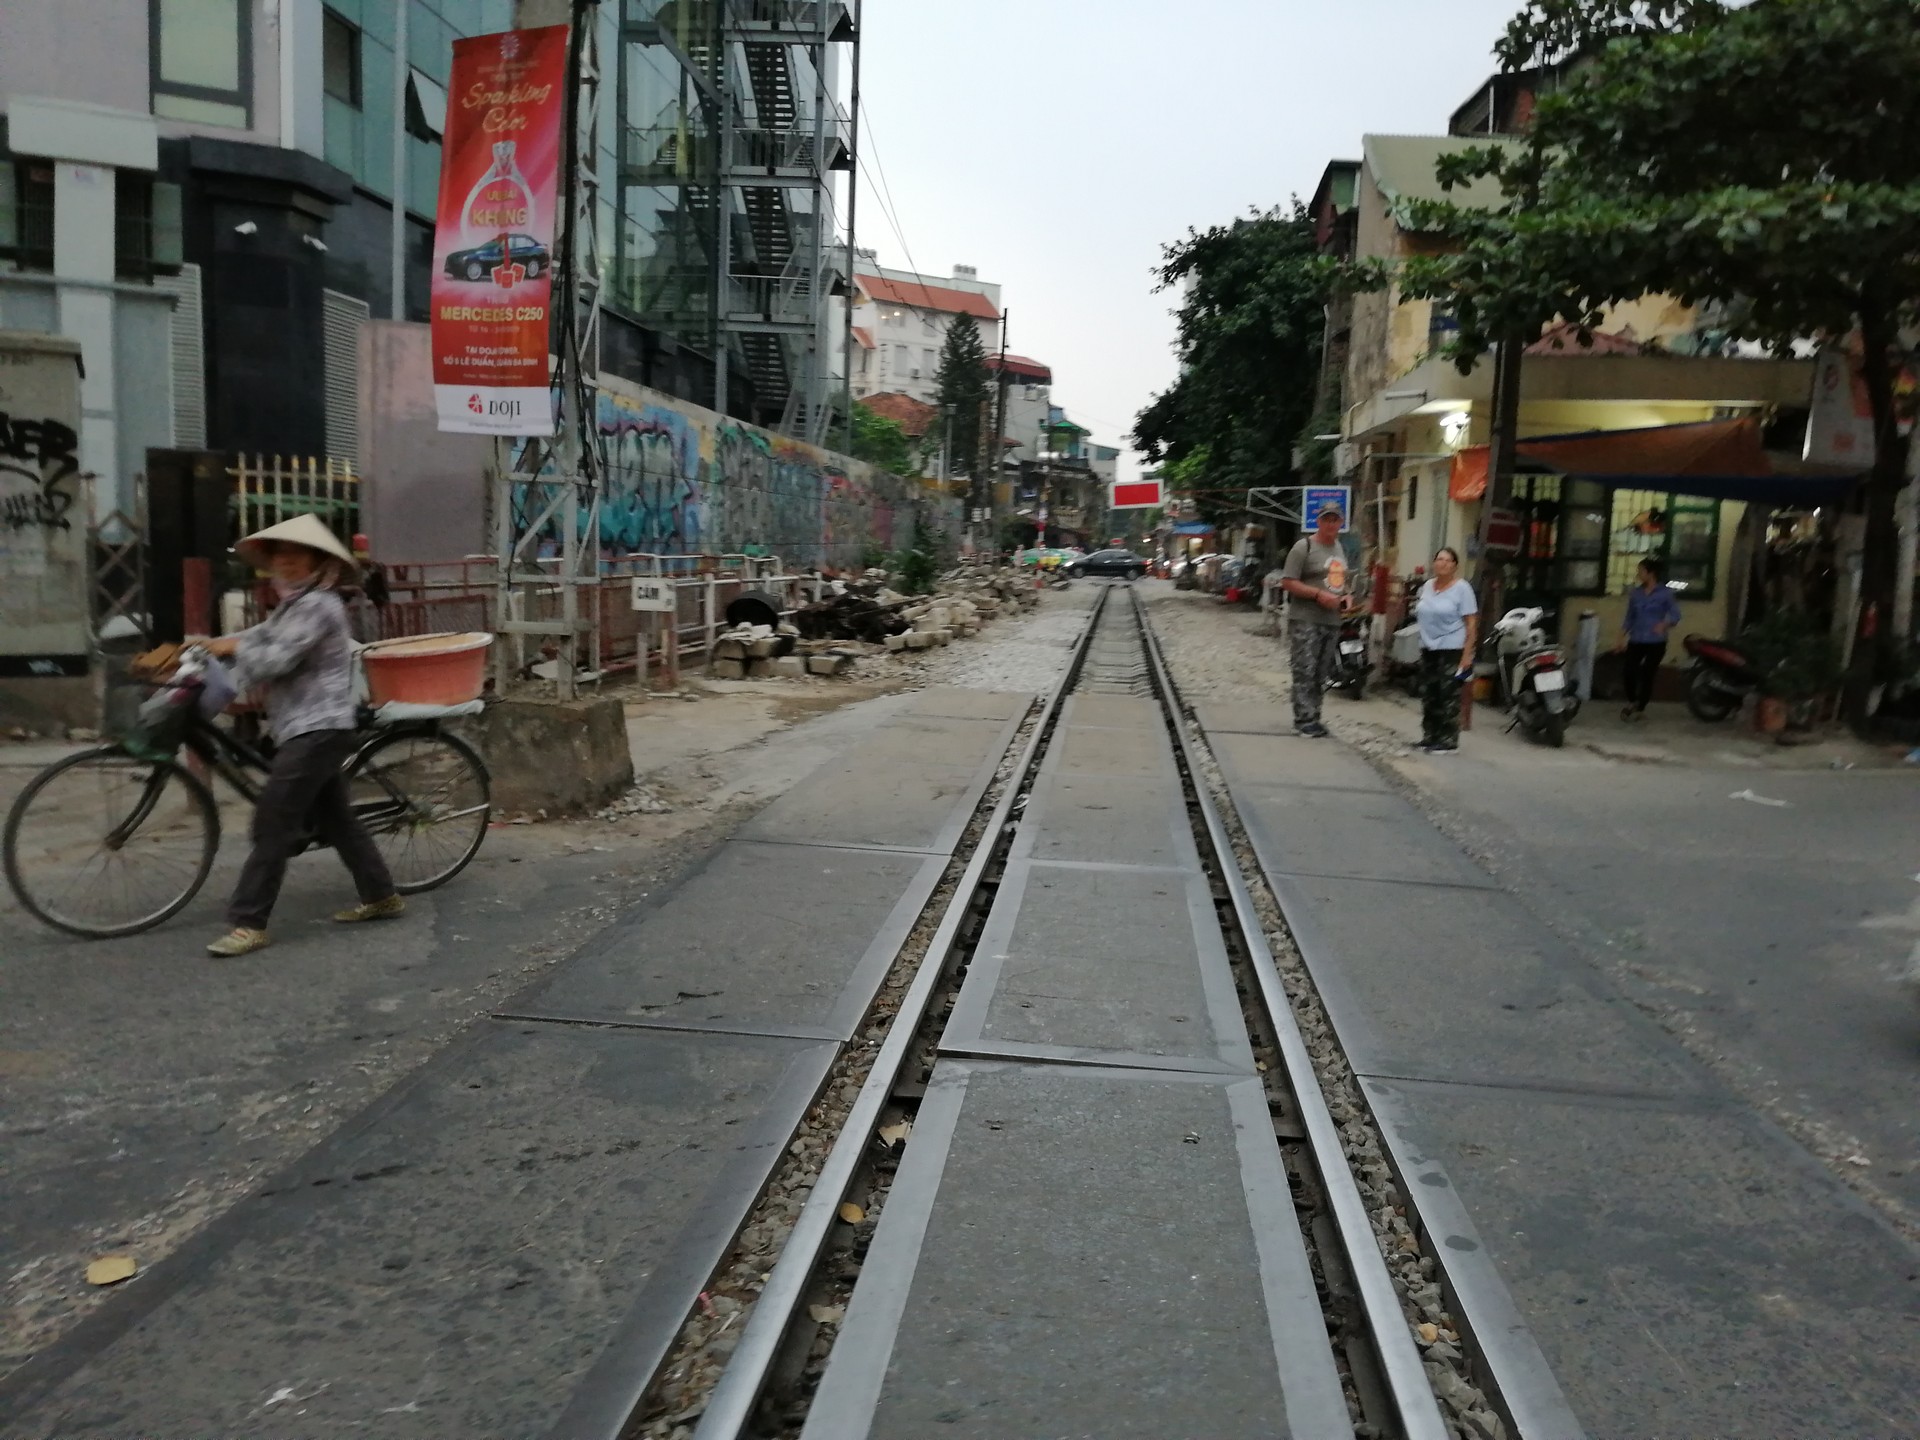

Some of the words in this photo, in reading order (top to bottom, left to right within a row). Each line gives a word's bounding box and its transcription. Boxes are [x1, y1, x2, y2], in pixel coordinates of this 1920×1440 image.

[440, 306, 513, 321] MERCEDES
[516, 307, 544, 320] C250
[489, 400, 520, 420] DOJI
